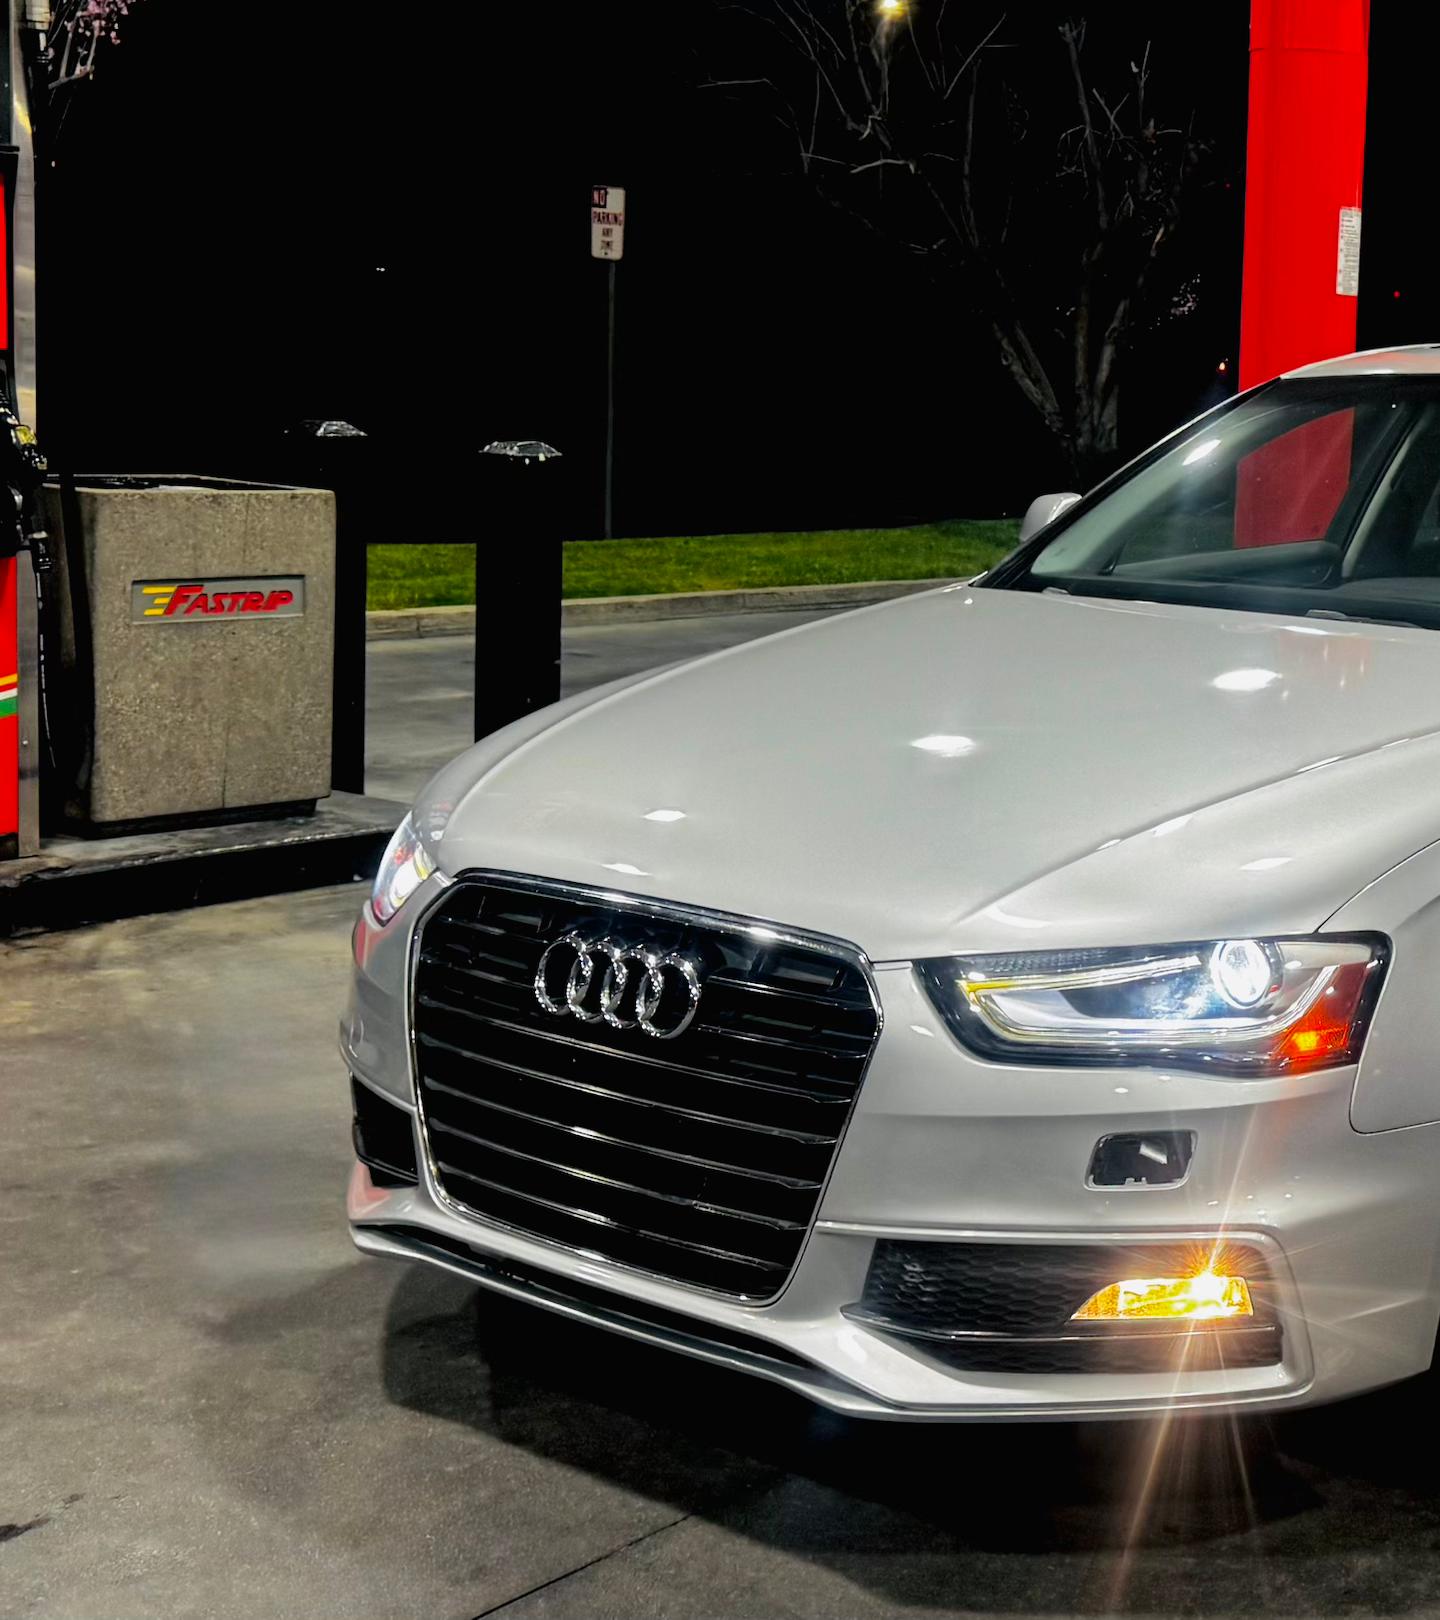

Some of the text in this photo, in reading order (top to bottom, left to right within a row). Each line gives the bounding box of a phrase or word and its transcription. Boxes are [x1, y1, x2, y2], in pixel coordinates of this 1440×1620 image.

[593, 189, 606, 206] NO
[592, 211, 624, 225] PARKING
[163, 584, 293, 616] FASTRIP
